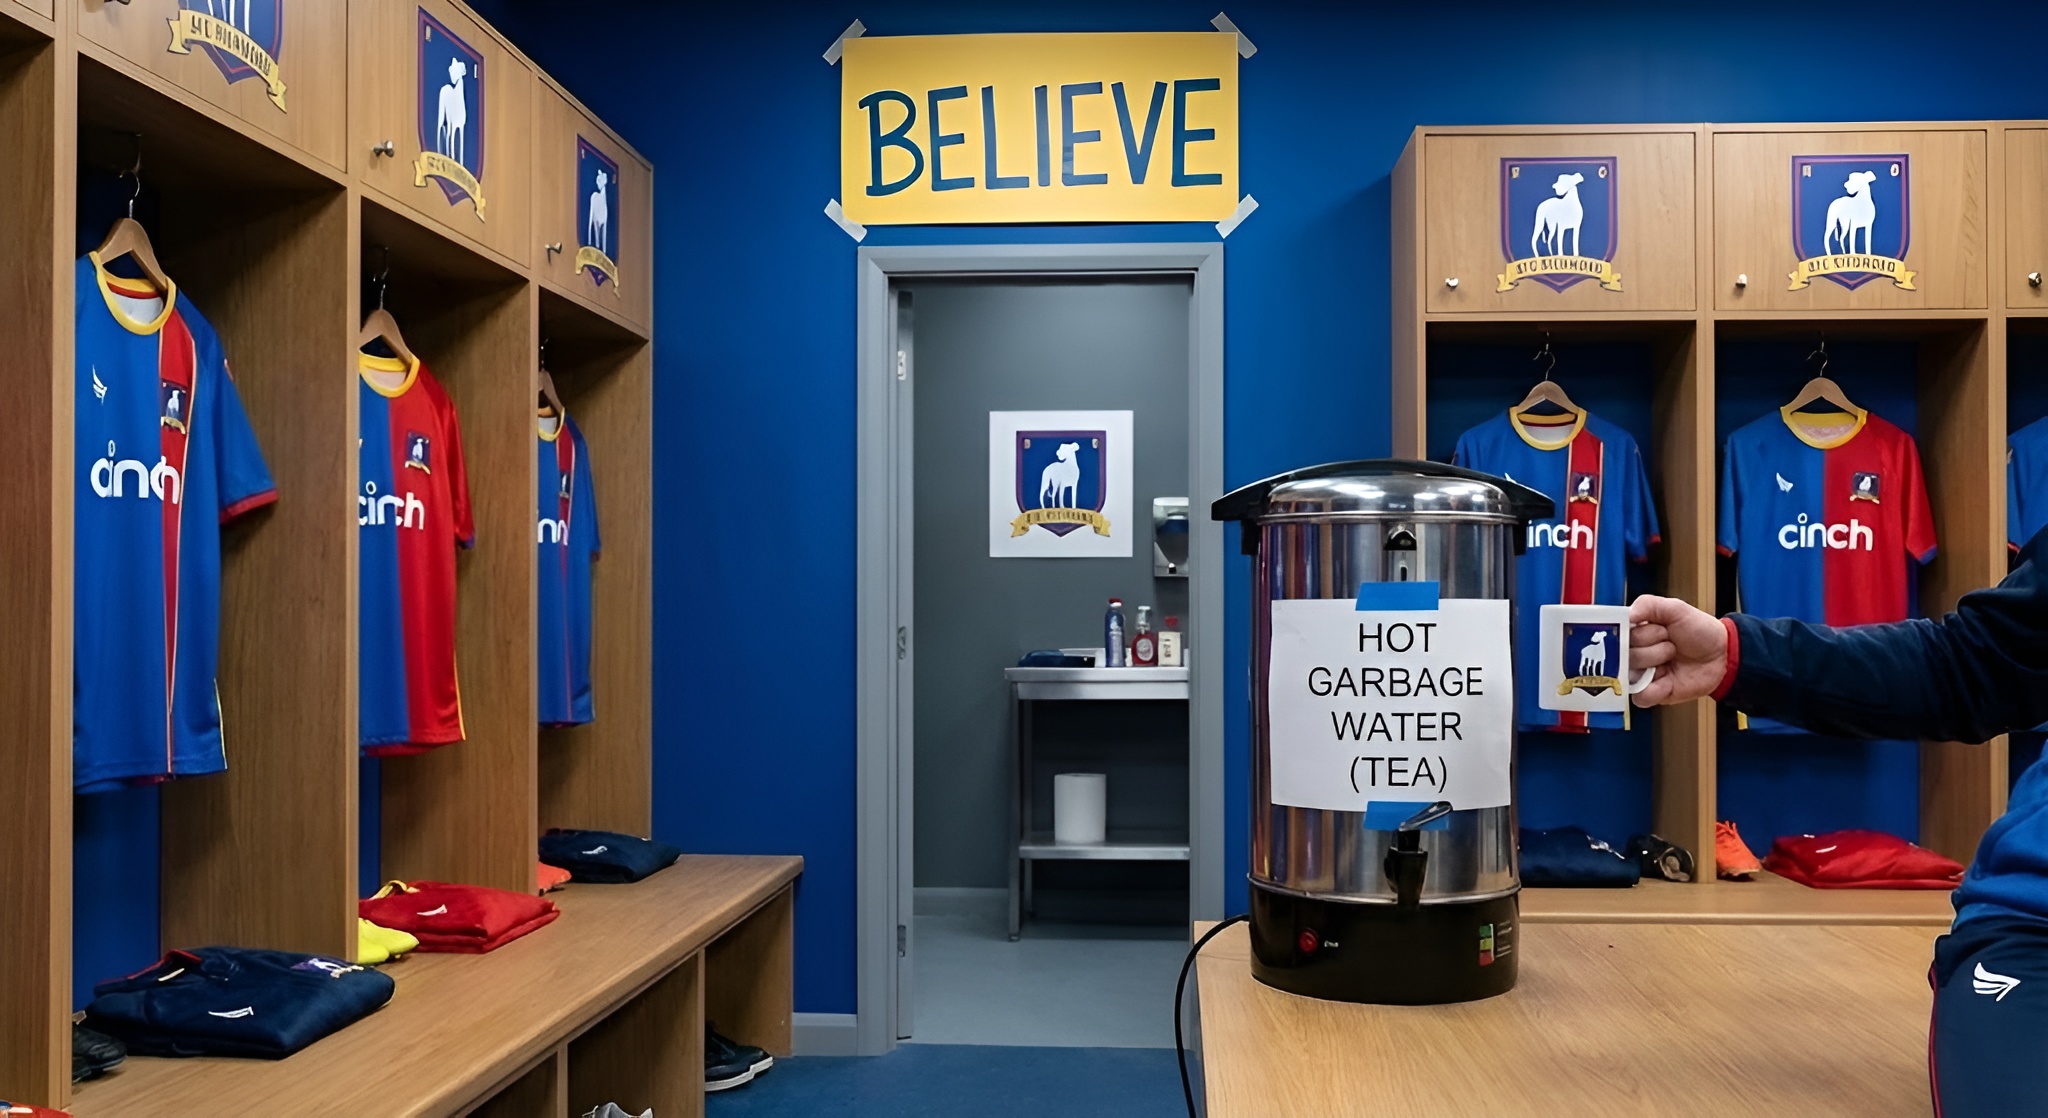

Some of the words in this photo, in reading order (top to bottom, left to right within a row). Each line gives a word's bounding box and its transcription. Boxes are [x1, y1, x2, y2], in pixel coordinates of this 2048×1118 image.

[858, 77, 1223, 197] BELIEVE
[1526, 519, 1594, 550] inch
[1778, 512, 1874, 551] cinch
[1359, 622, 1437, 653] HOT
[1308, 666, 1484, 698] GARBAGE
[1331, 711, 1463, 742] WATER
[1350, 755, 1447, 793] (TEA)
